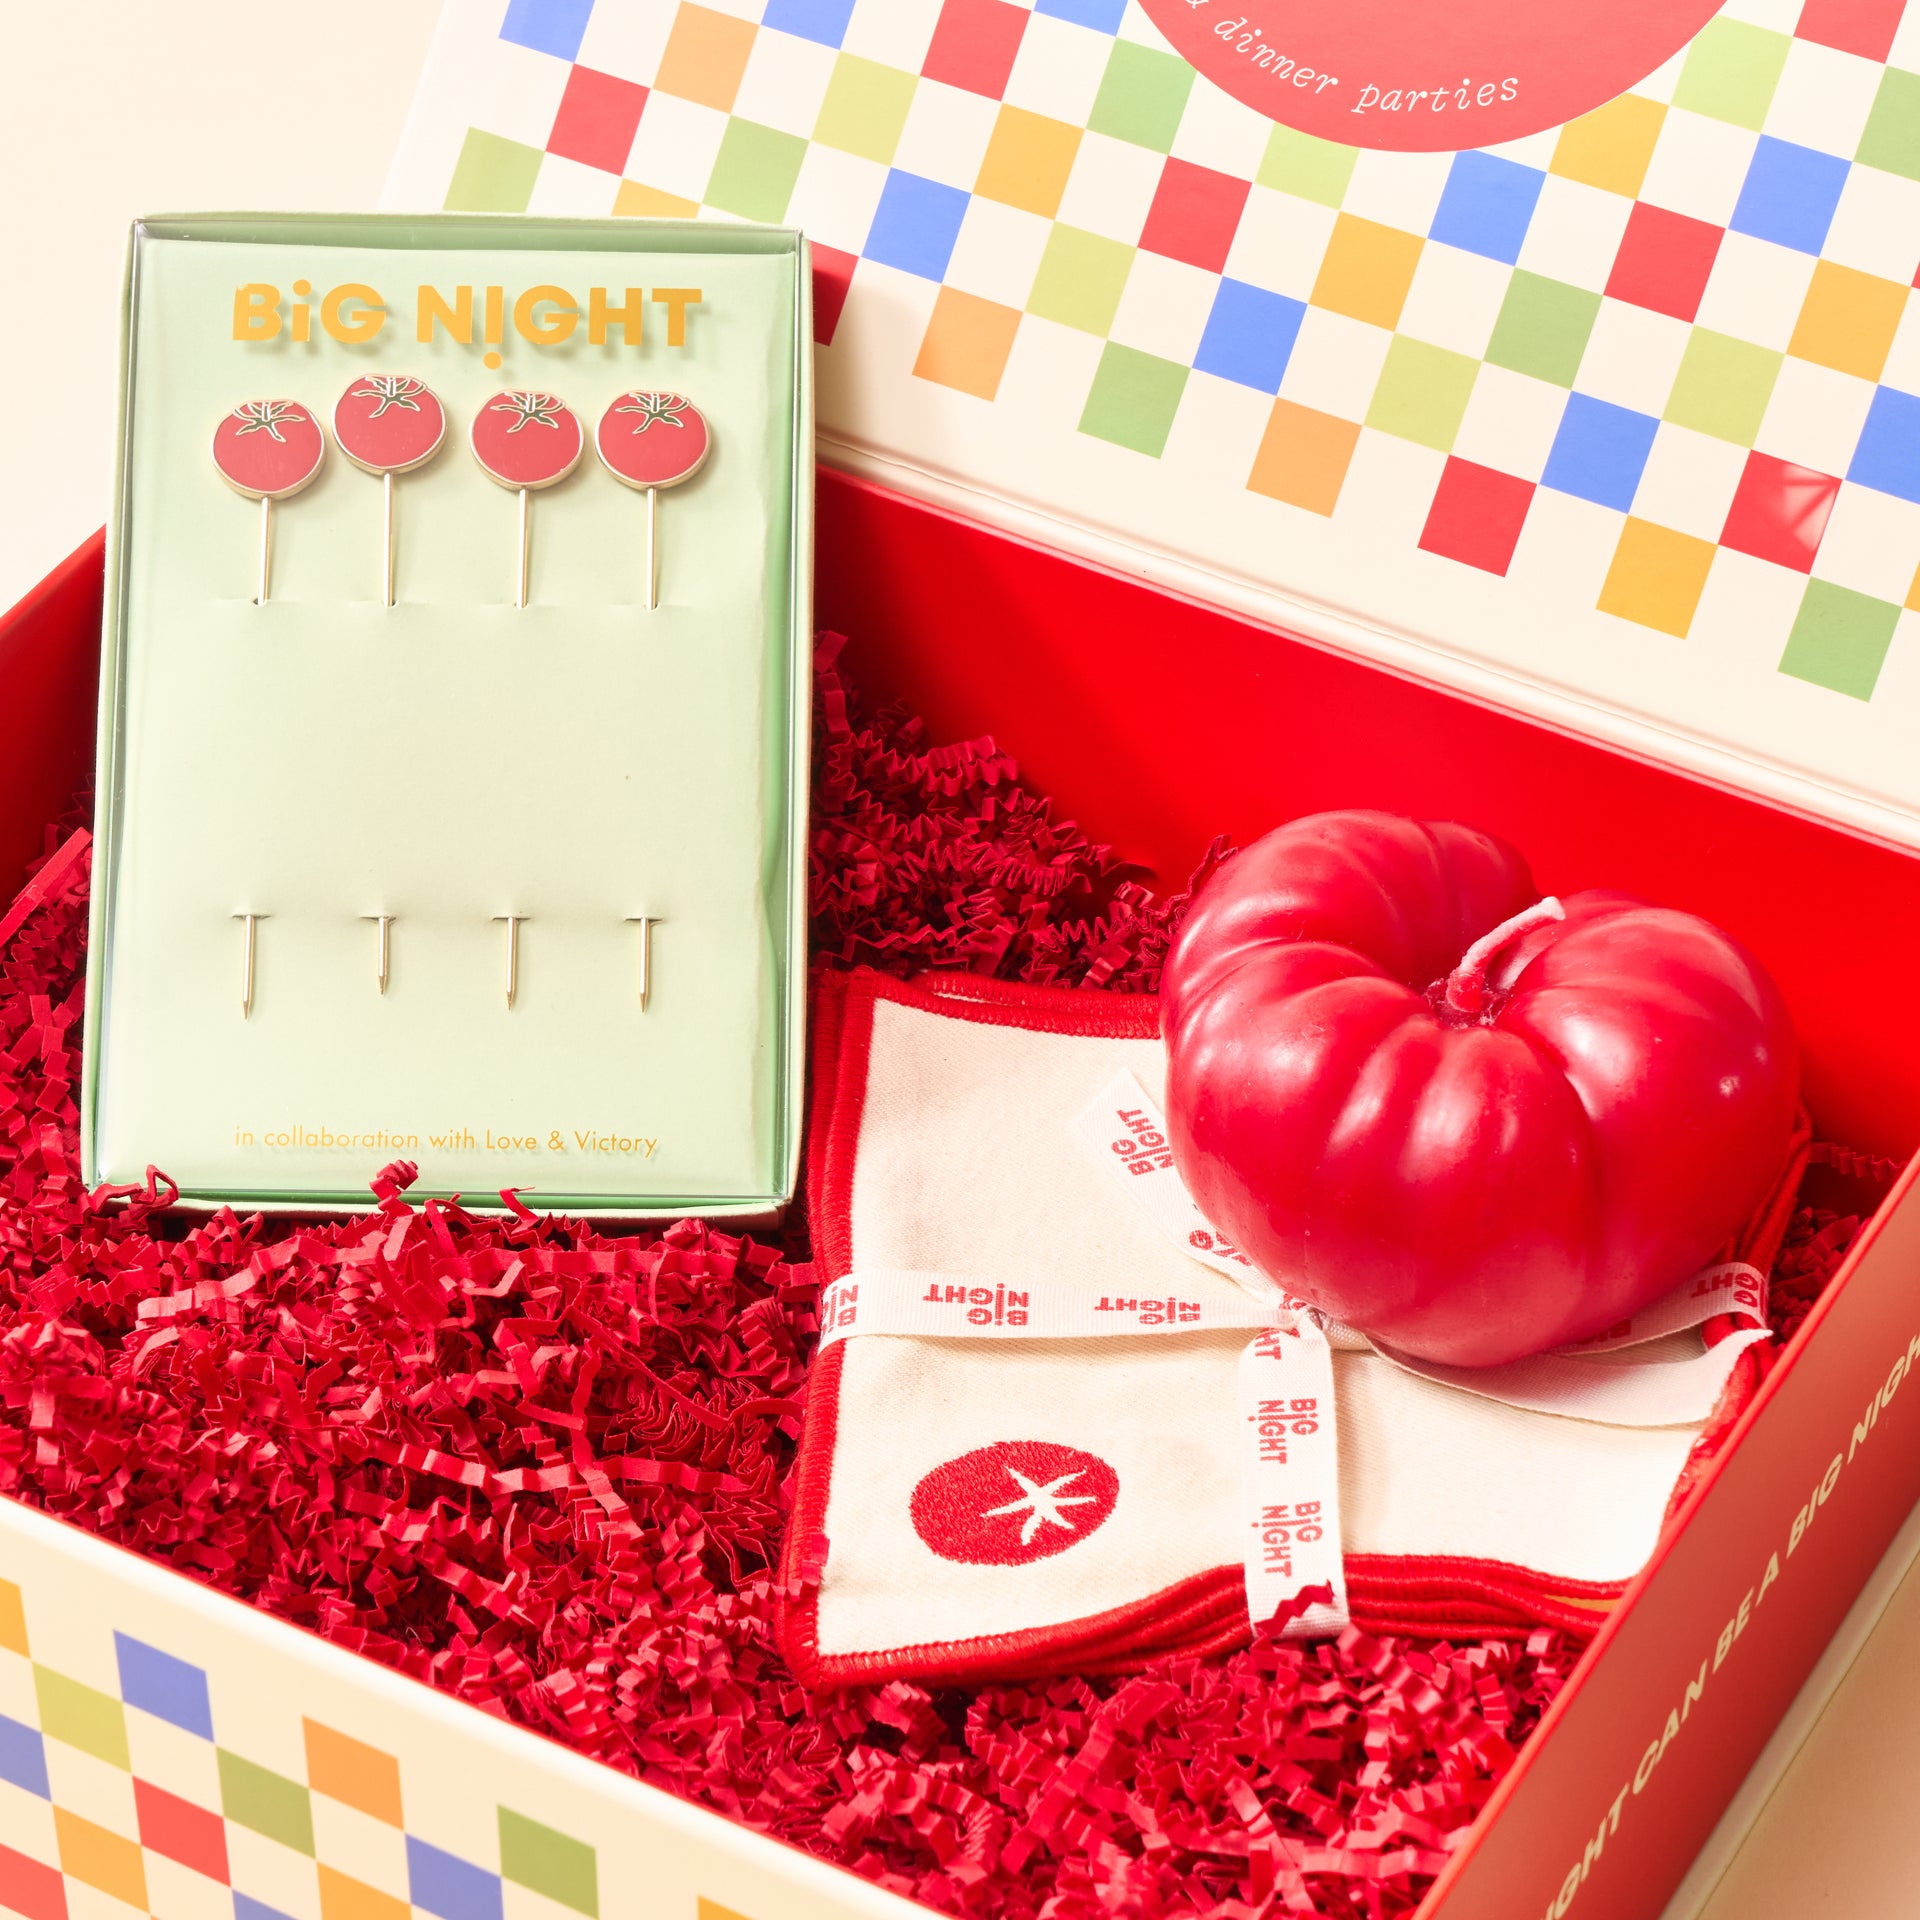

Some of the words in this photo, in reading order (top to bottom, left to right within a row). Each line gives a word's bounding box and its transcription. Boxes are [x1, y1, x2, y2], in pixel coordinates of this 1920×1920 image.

[1213, 16, 1339, 94] dinner
[1350, 77, 1519, 114] parties
[235, 1126, 254, 1146] in
[264, 1124, 418, 1148] collaboration
[429, 1128, 475, 1150] with
[486, 1129, 537, 1150] Love
[547, 1130, 565, 1151] &
[574, 1131, 657, 1158] Victory
[1632, 1658, 1707, 1795] CAN
[1712, 1586, 1755, 1675] BE
[1755, 1551, 1779, 1608] A
[1786, 1453, 1843, 1560] BIG
